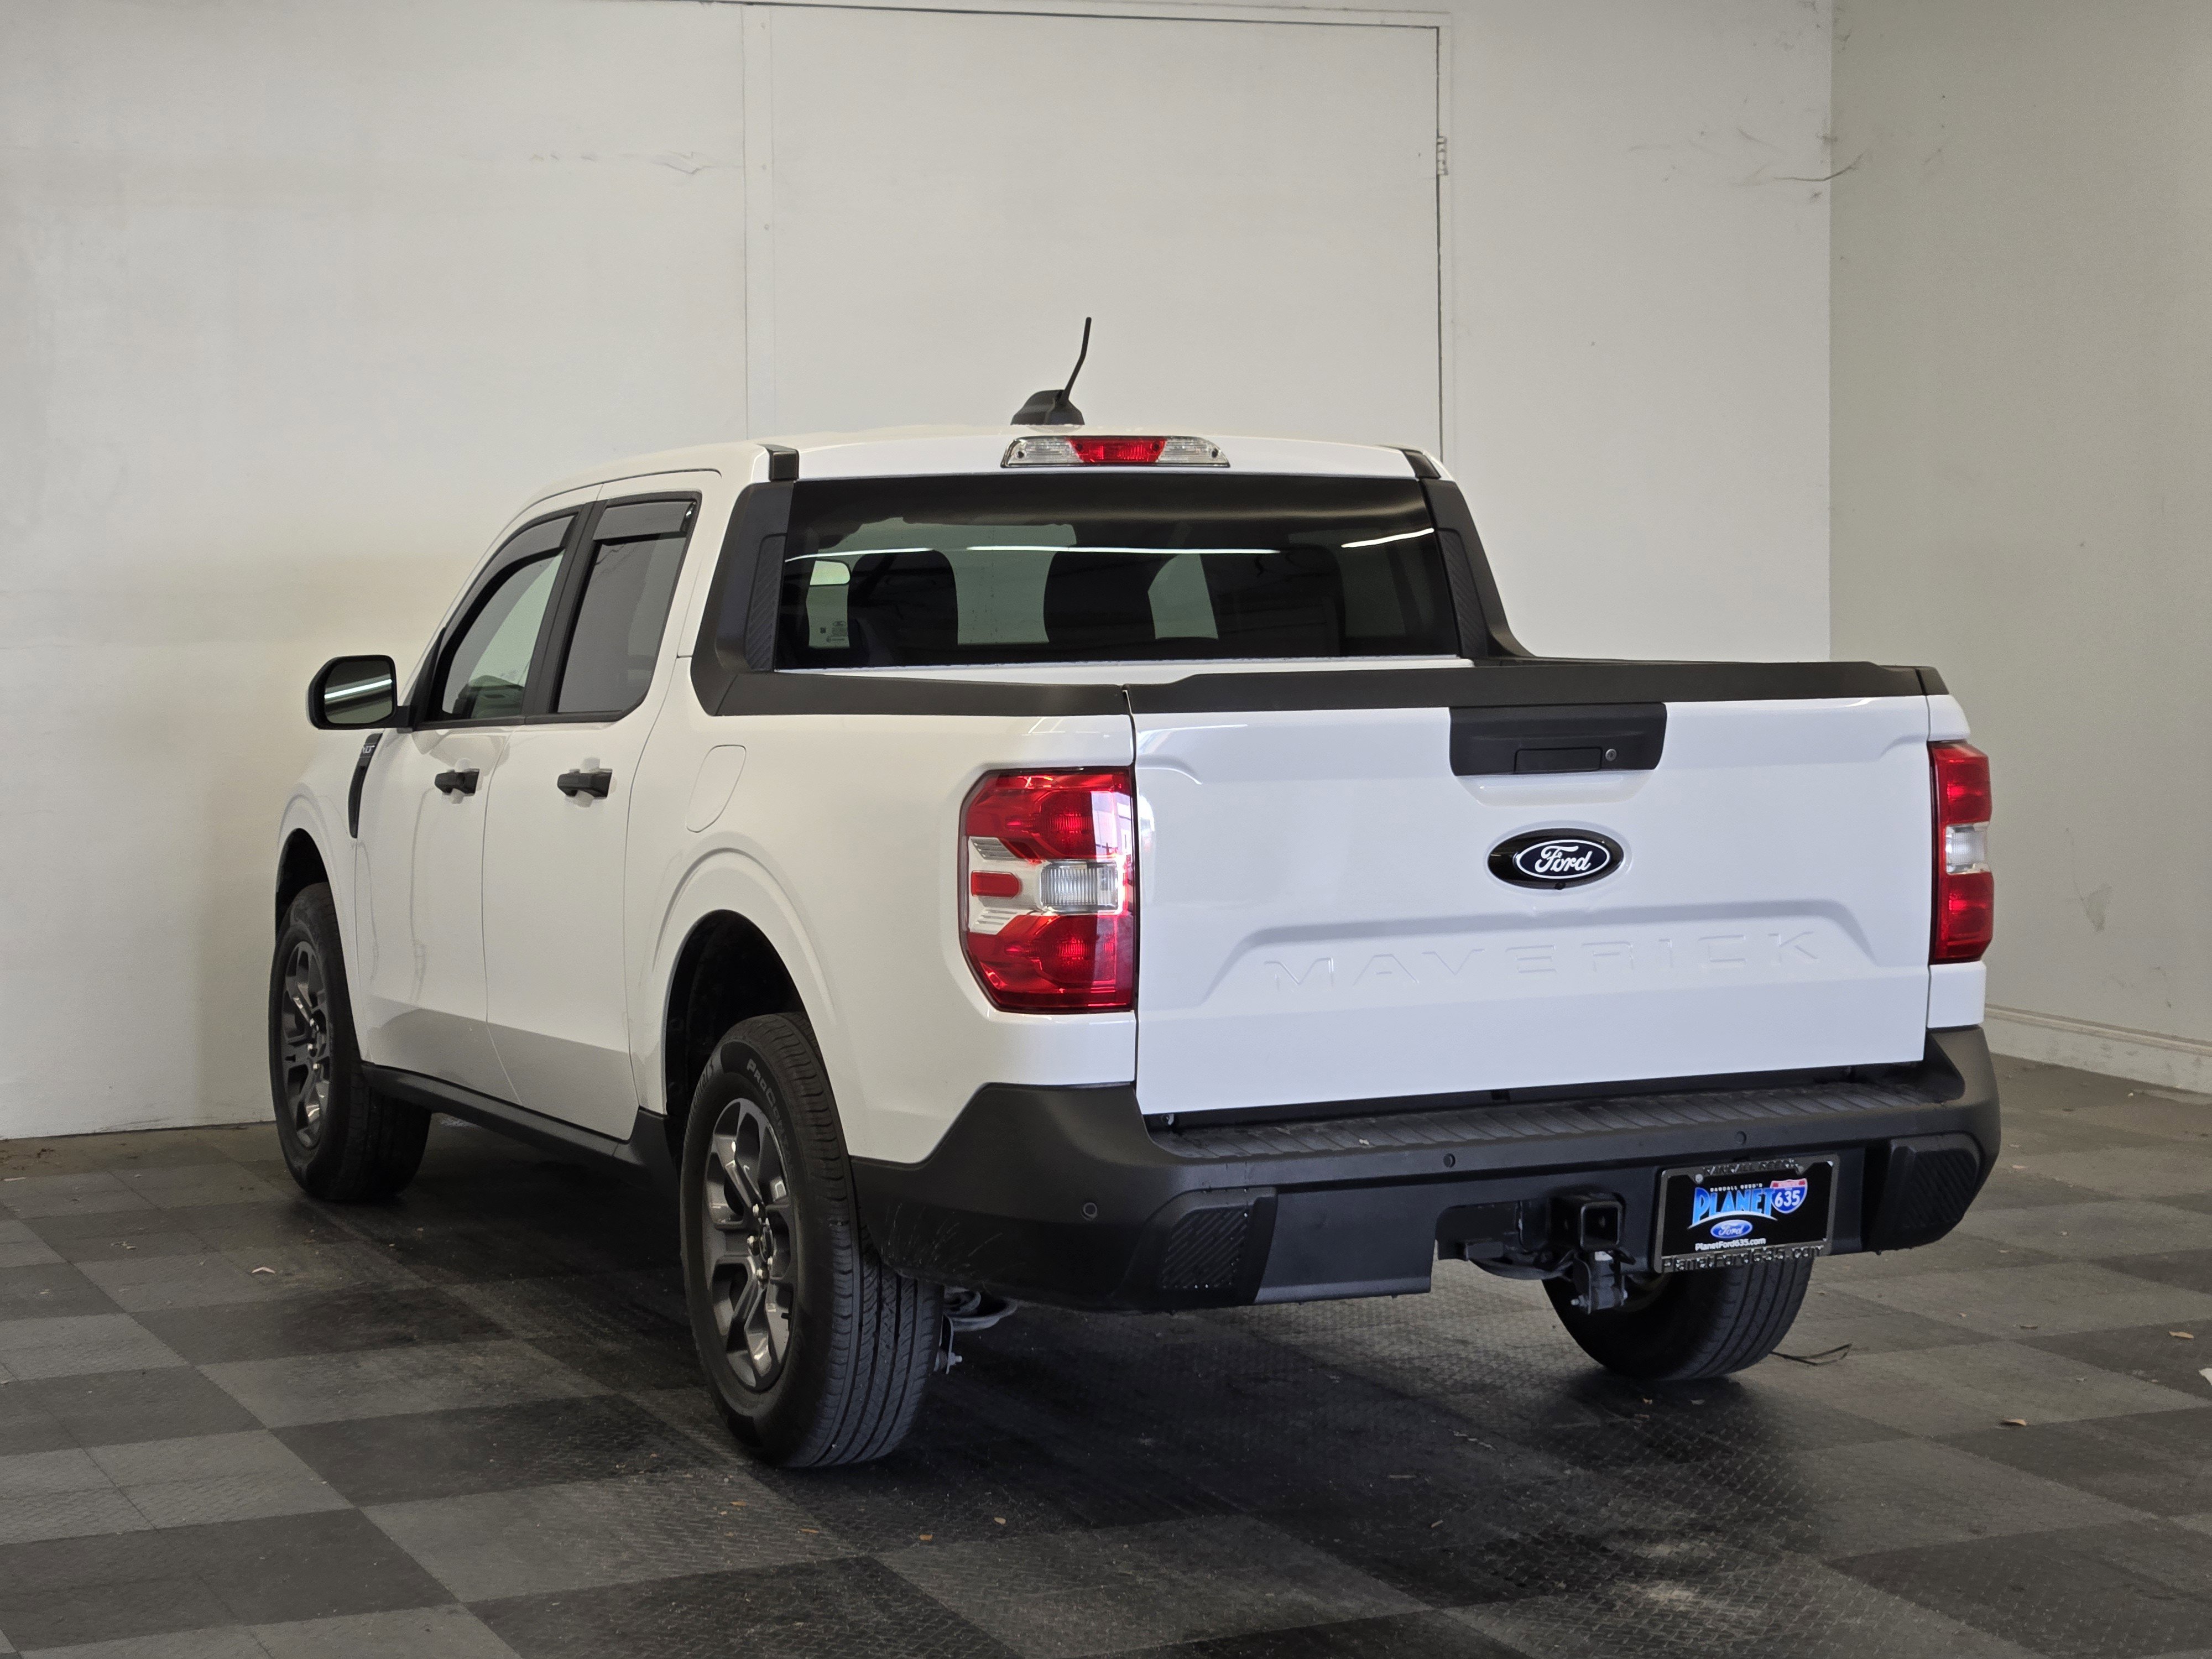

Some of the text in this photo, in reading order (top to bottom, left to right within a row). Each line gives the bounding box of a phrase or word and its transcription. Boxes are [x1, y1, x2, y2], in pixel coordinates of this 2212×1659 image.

[1534, 845, 1593, 873] Ford
[1263, 931, 1819, 992] MAVERICK
[1692, 1186, 1801, 1225] PLANET 635
[1718, 1224, 1744, 1236] Ford
[1694, 1238, 1767, 1251] PlanetFord635.com
